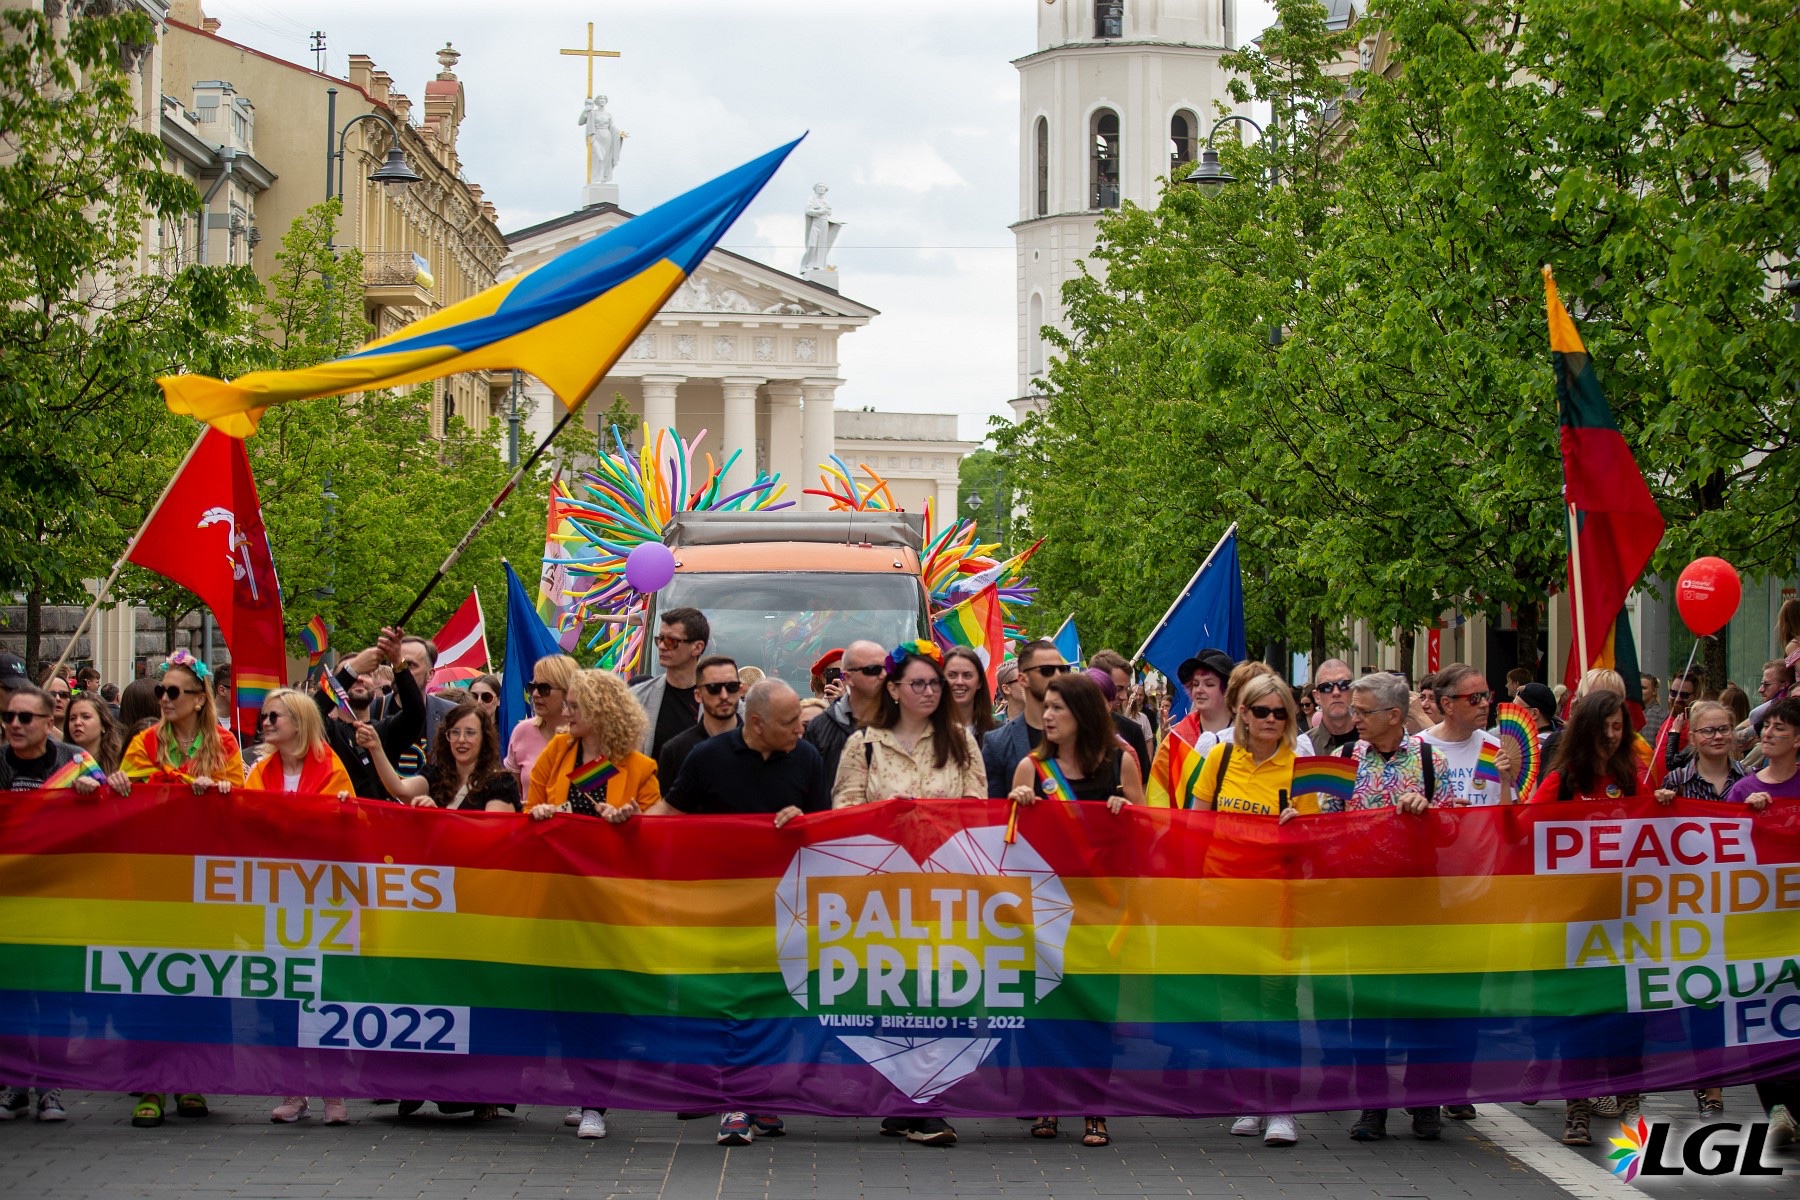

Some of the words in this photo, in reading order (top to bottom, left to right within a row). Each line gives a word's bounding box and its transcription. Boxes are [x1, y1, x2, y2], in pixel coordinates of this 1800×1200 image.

[1447, 767, 1473, 778] WAY
[1218, 796, 1270, 815] SWEDEN
[1546, 822, 1745, 869] PEACE
[204, 856, 442, 909] EITYNĖS
[1626, 867, 1800, 917] PRIDE
[276, 899, 354, 952] UŽ
[817, 888, 1025, 943] BALTIC
[1575, 919, 1712, 967] AND
[90, 950, 316, 1013] LYGYBĘ
[818, 944, 1025, 1008] PRIDE
[1638, 958, 1800, 1011] EQUA
[317, 1004, 456, 1051] 2022
[818, 1014, 874, 1027] VILNIUS
[881, 1012, 948, 1029] BIRŽELIO
[987, 1016, 1025, 1029] 2022
[1737, 996, 1800, 1044] FO
